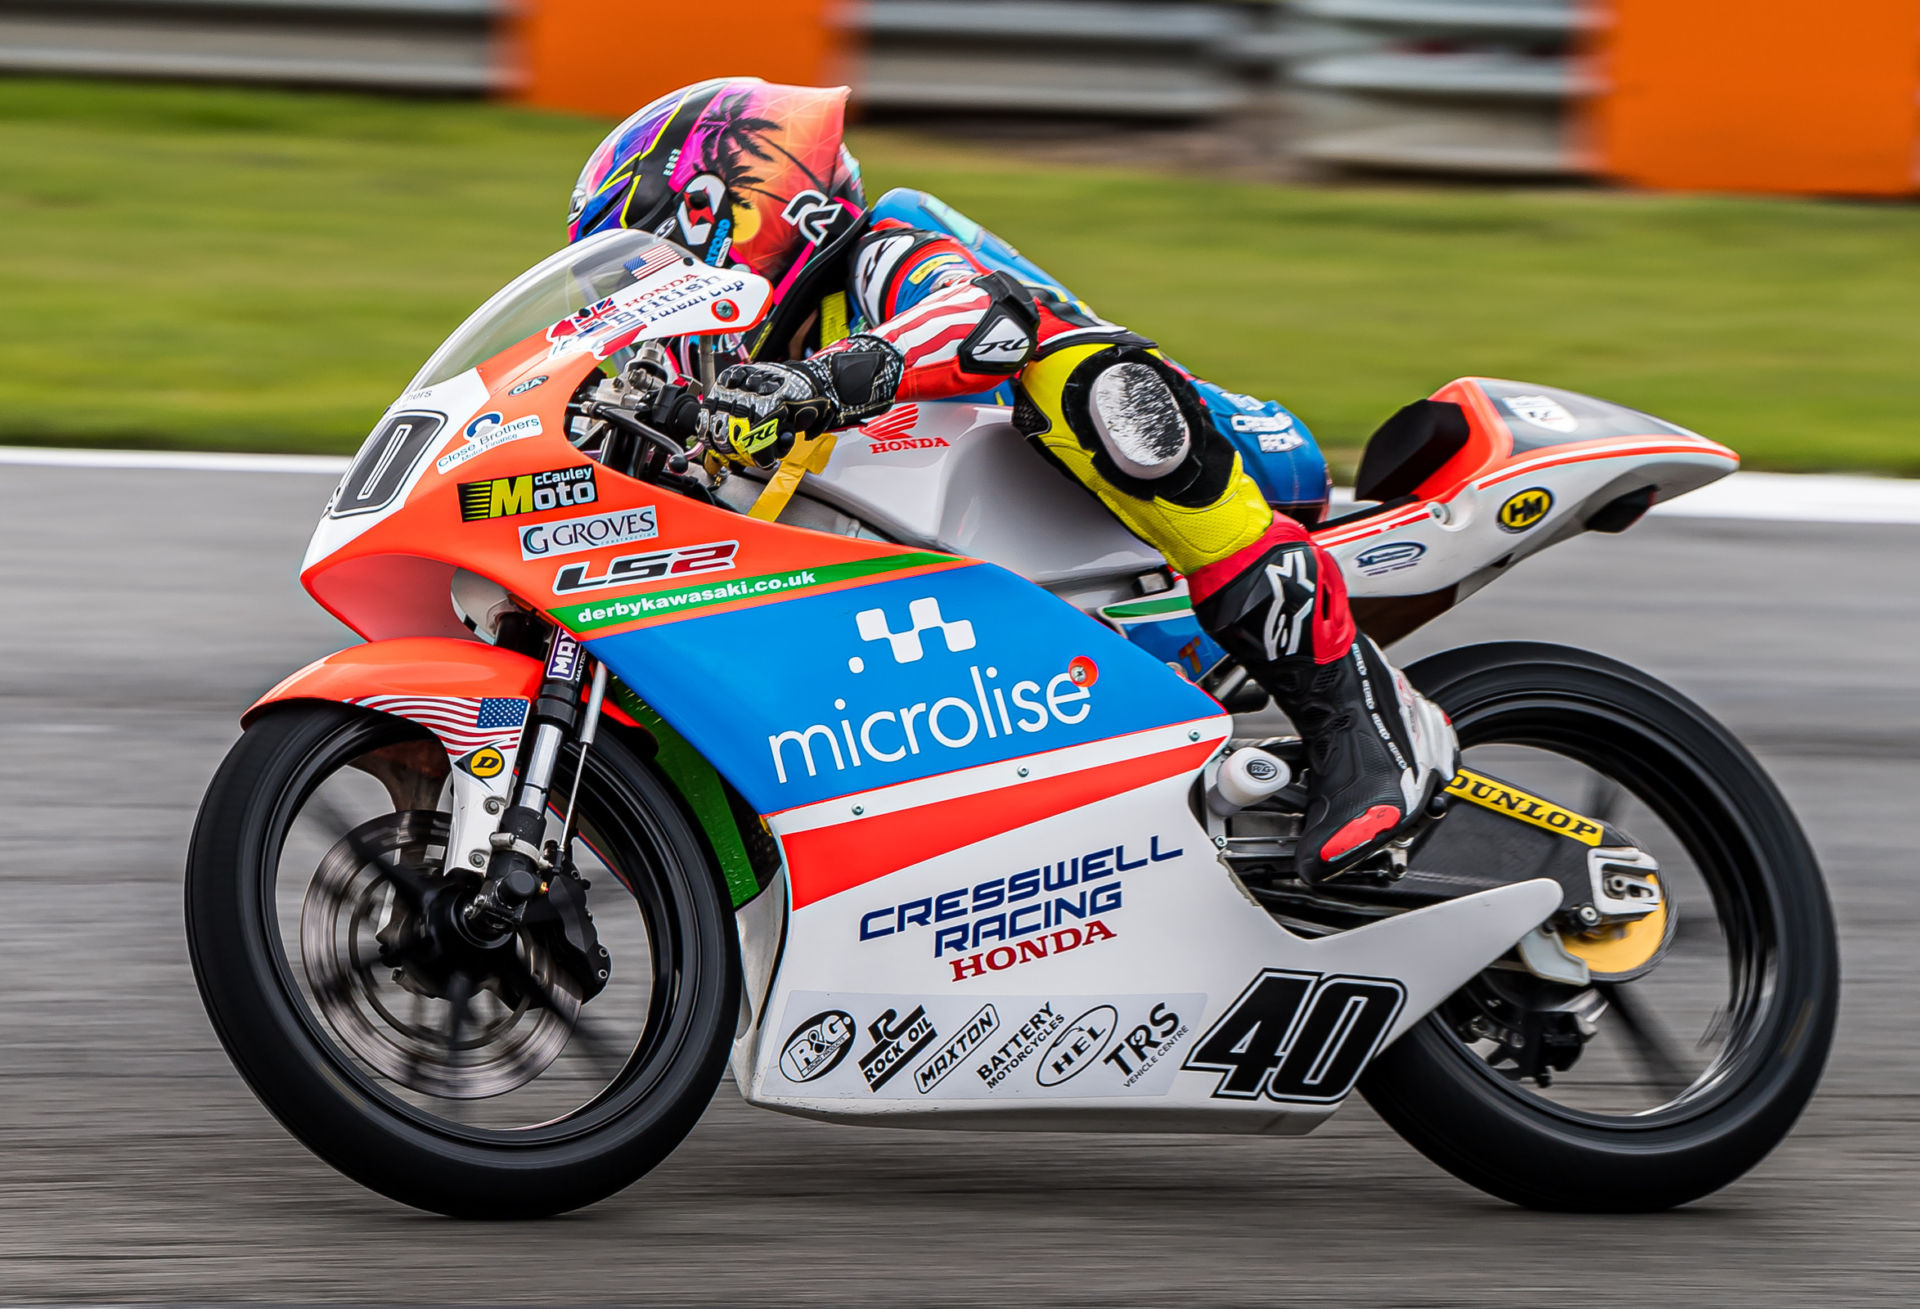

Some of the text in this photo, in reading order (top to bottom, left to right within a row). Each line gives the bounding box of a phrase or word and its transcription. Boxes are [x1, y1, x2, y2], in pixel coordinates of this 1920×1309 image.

[610, 275, 721, 325] British
[624, 273, 700, 308] HONDA
[438, 418, 539, 467] Close Brothers
[485, 433, 518, 449] Finance
[868, 436, 951, 454] HONDA
[552, 511, 655, 546] GROVES
[556, 543, 737, 592] LS2
[577, 571, 816, 623] derbykawasaki.co.uk
[768, 665, 1091, 784] microlise
[1450, 774, 1597, 836] DUNLOP
[859, 835, 1183, 942] CRESSWELL
[934, 881, 1122, 958] RACING
[949, 919, 1117, 982] HONDA
[788, 1014, 849, 1072] R&G
[863, 1016, 933, 1083] ROCK OIL
[920, 1011, 993, 1088] MAXTON
[976, 1001, 1054, 1081] BATTERY
[986, 1014, 1065, 1089] MOTORCYCLES
[1051, 1026, 1106, 1075] HEL
[1103, 1002, 1179, 1077] TRS
[1123, 1025, 1190, 1088] VEHICLE CENTRE
[1181, 968, 1407, 1105] 40
